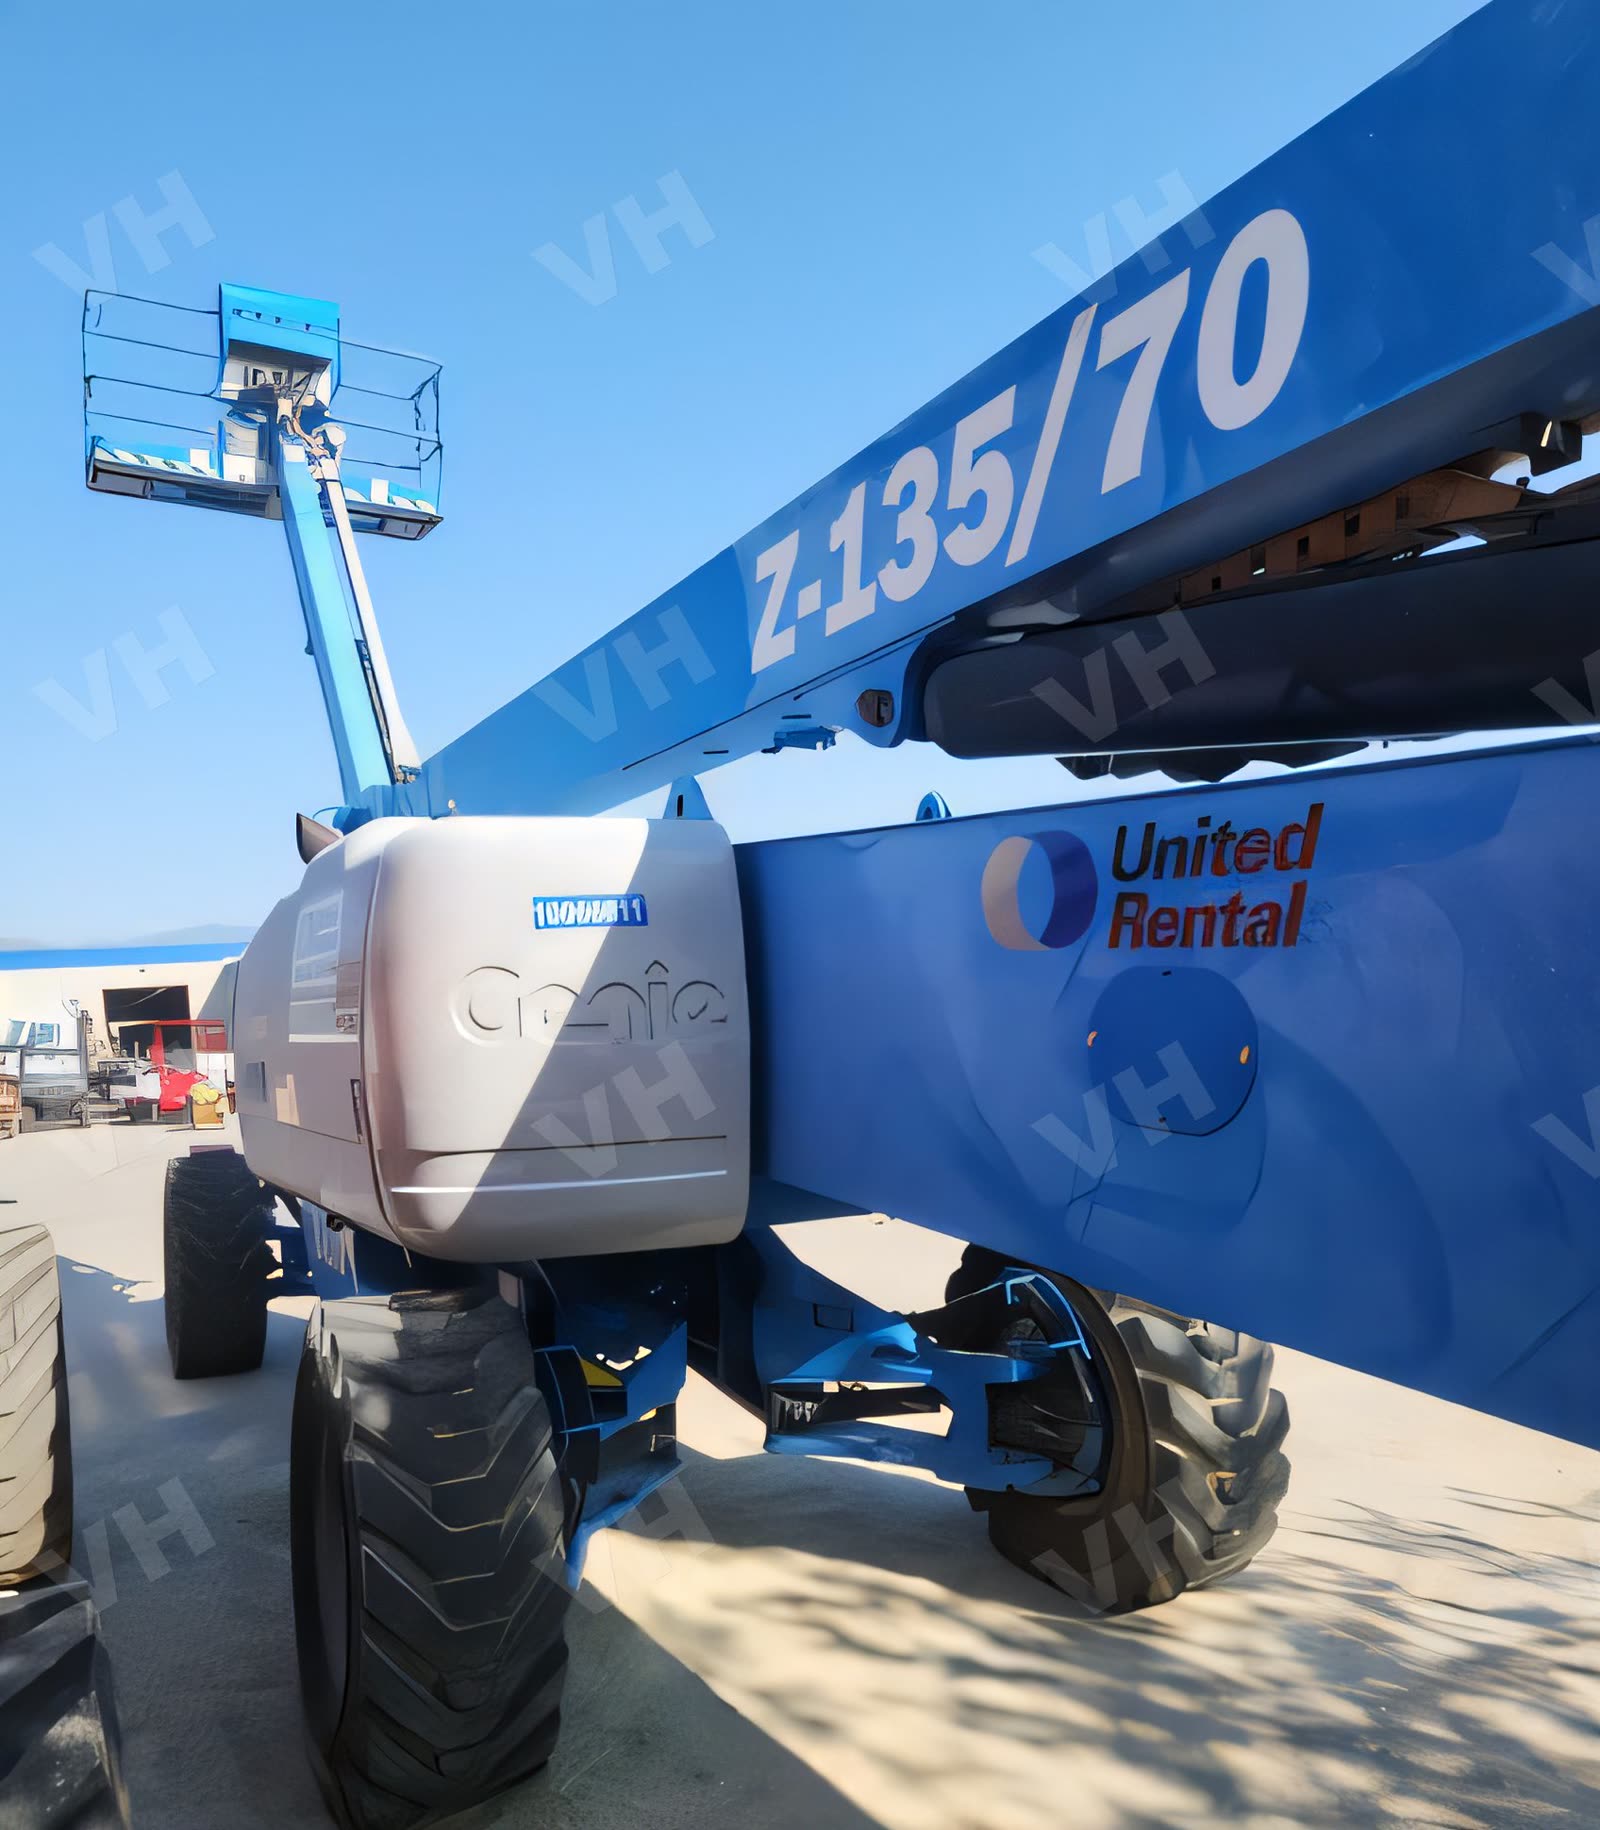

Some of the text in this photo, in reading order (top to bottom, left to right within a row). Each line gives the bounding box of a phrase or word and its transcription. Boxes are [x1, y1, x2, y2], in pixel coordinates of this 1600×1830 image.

[751, 208, 1310, 675] Z-135/70
[1112, 803, 1324, 882] United
[1108, 880, 1308, 949] Rental
